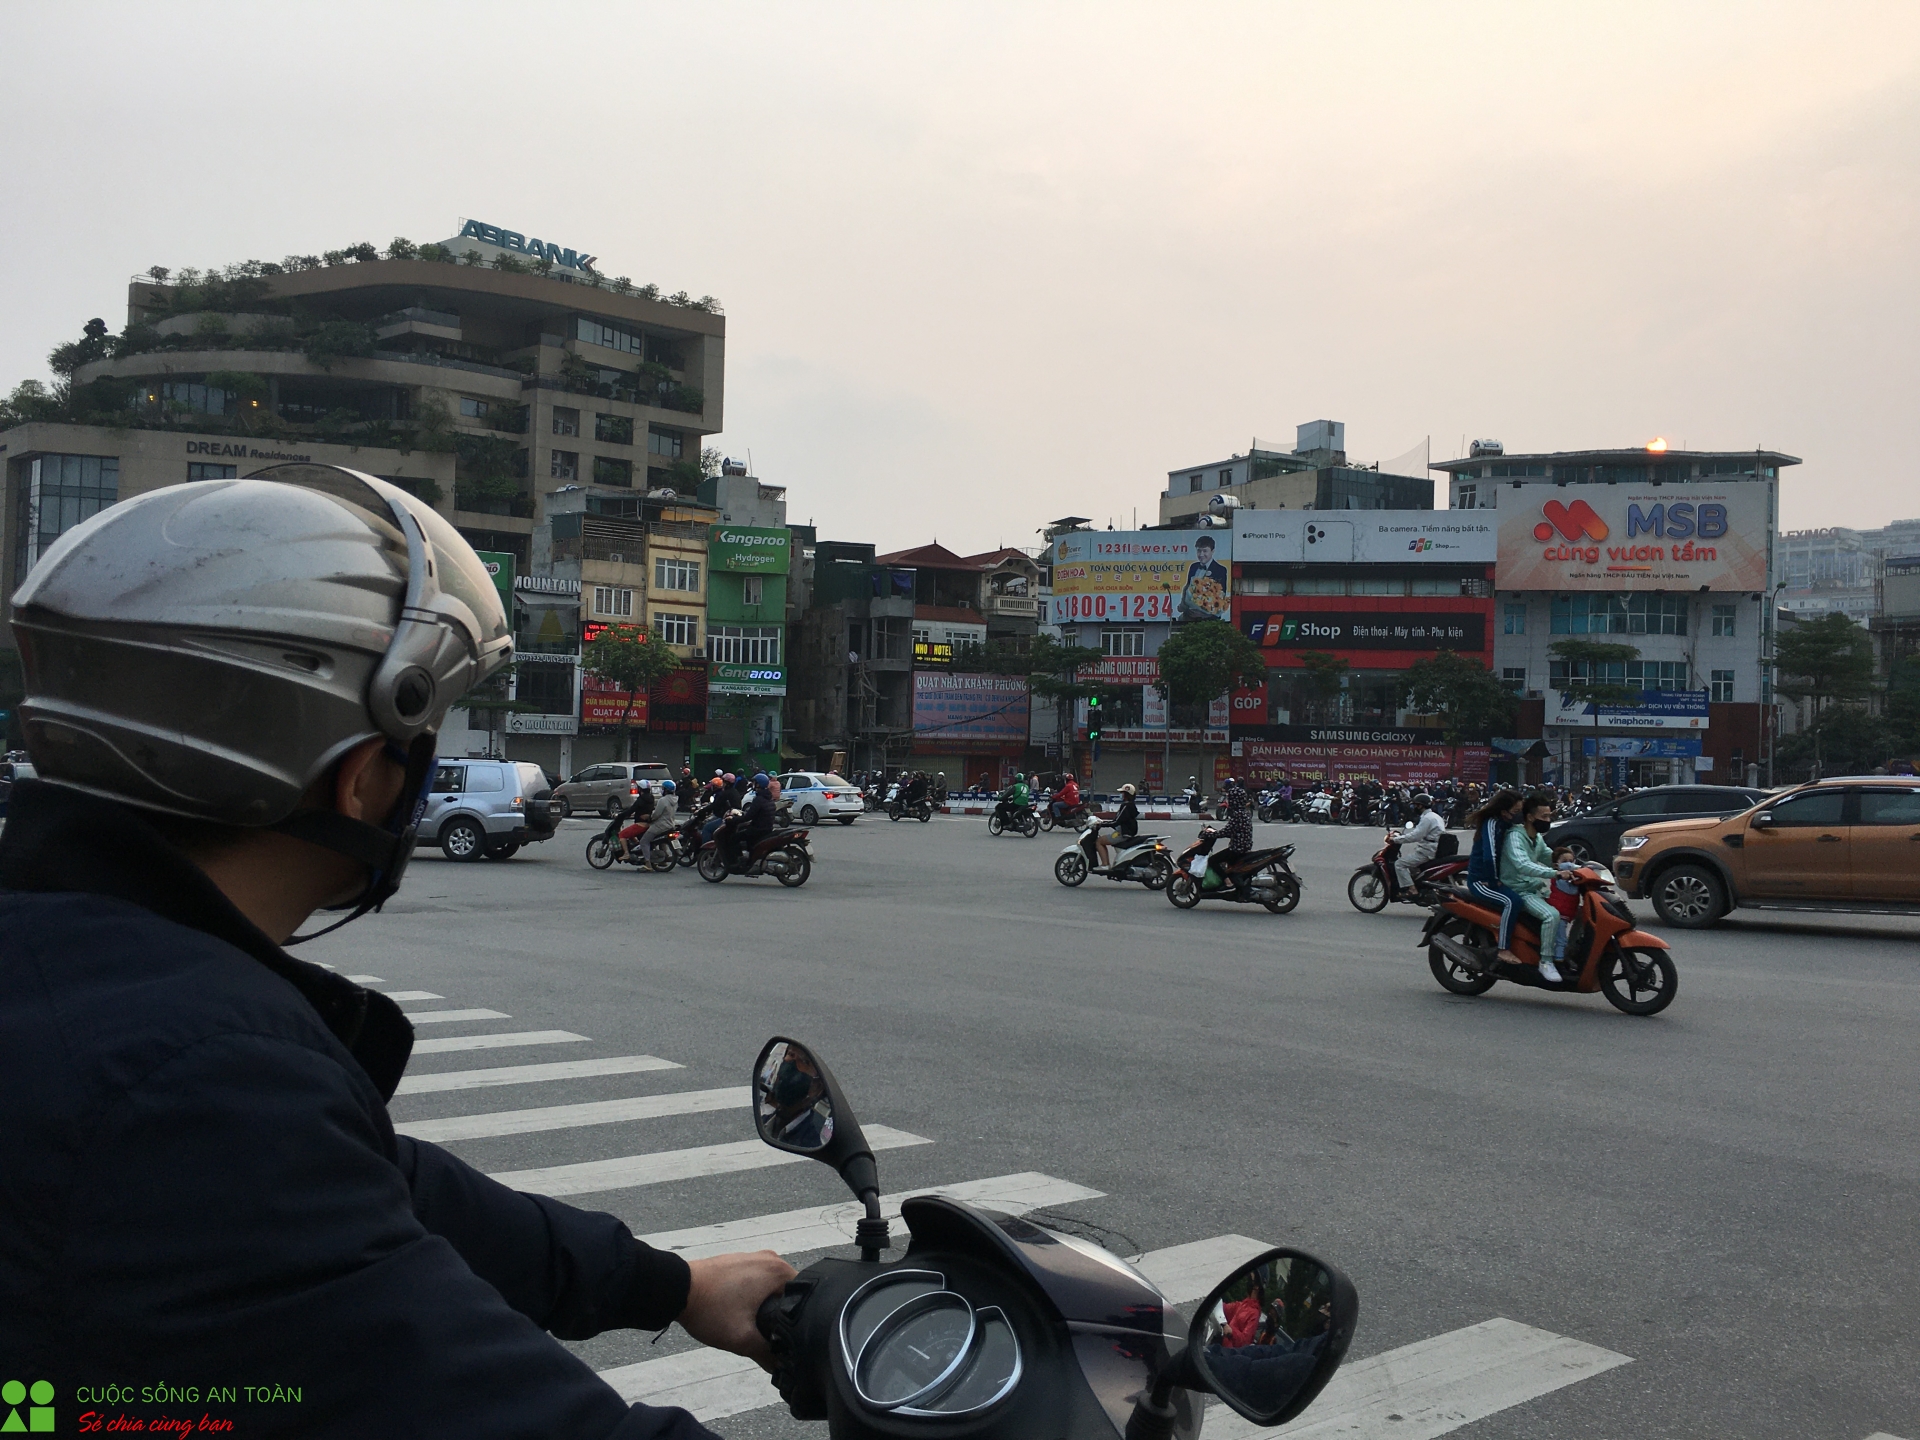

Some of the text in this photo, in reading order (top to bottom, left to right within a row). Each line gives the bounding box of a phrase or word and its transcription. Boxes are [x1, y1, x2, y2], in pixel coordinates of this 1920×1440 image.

[460, 219, 598, 273] ABBANK
[186, 441, 311, 462] DREAM Residences
[1626, 502, 1728, 539] MSB
[714, 530, 785, 546] Kangaroo
[736, 554, 774, 564] Hydrogen
[1544, 540, 1716, 564] cùng vươn tầm
[1070, 568, 1085, 578] HOA
[1113, 563, 1137, 573] QUỐC
[1150, 563, 1174, 573] QUỐC
[515, 576, 582, 592] MOUNTAIN
[1065, 595, 1172, 618] 1800-1234
[1301, 623, 1341, 639] Shop
[1353, 626, 1369, 639] Điện
[1371, 626, 1388, 639] thoại
[1395, 626, 1408, 639] Máy
[1412, 626, 1425, 637] tính
[1432, 626, 1444, 640] Phụ
[1448, 626, 1463, 640] kiện
[915, 644, 928, 655] NHO
[934, 645, 952, 656] HOTEL
[712, 665, 782, 680] Kangaroo
[1116, 662, 1136, 677] QUẠT
[1137, 659, 1156, 678] ĐIỆN
[917, 675, 1027, 691] QUẠT NHẬT KHÁNH PHƯƠNG
[617, 700, 630, 708] QUẠ
[1234, 693, 1262, 709] GÓP
[593, 708, 614, 718] QUẠT
[526, 720, 573, 730] MOUNTAIN
[1608, 717, 1654, 726] vinaphone
[1310, 730, 1416, 744] SAMSUNG Galaxy
[1252, 744, 1446, 760] BÁN HÀNG ONLINE GIAO HÀNG TẬN NHÀ
[1250, 771, 1256, 779] 4
